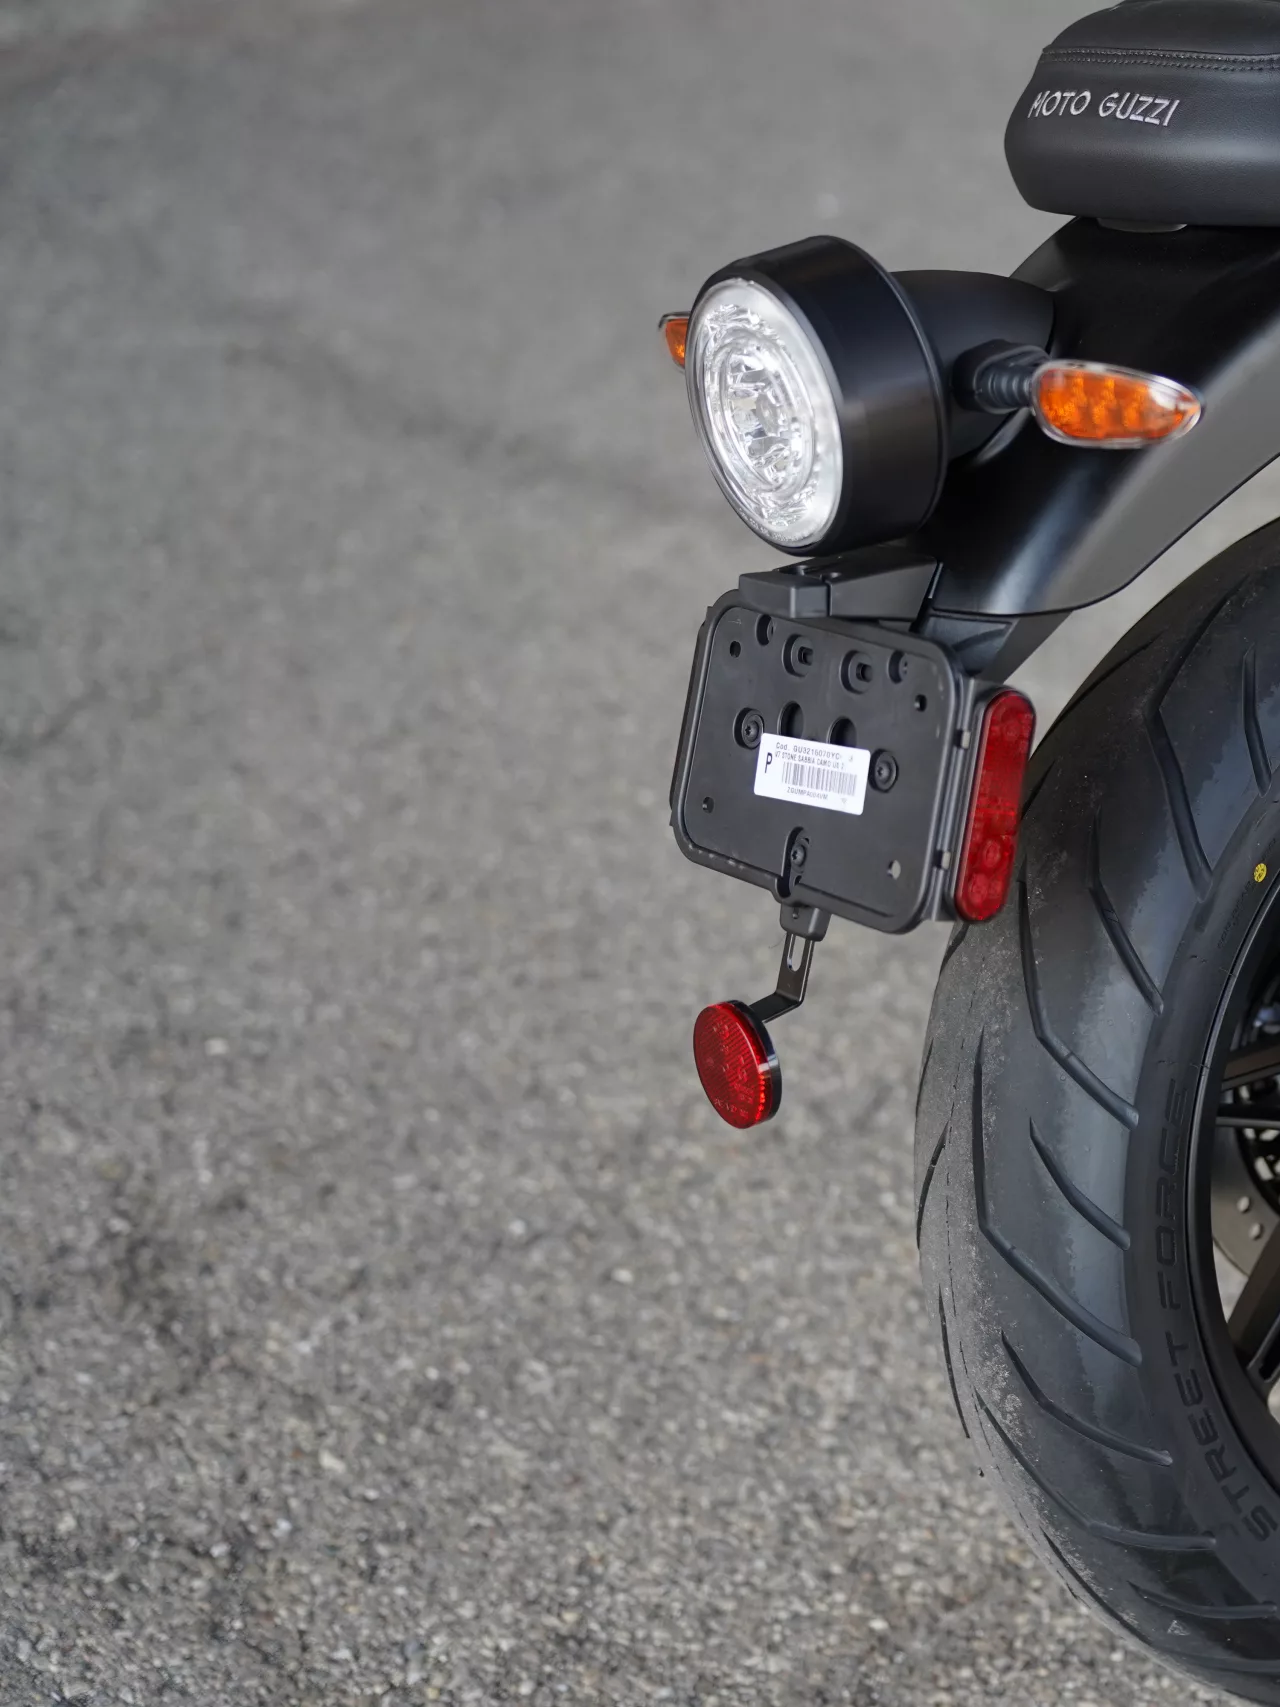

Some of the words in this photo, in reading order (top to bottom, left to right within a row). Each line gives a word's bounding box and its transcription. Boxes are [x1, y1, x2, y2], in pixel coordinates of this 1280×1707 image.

[1027, 90, 1092, 118] MOTO
[1098, 92, 1181, 127] GUZZI
[764, 752, 773, 773] P
[1155, 1077, 1188, 1311] FORCE
[1165, 1330, 1279, 1542] STREET
